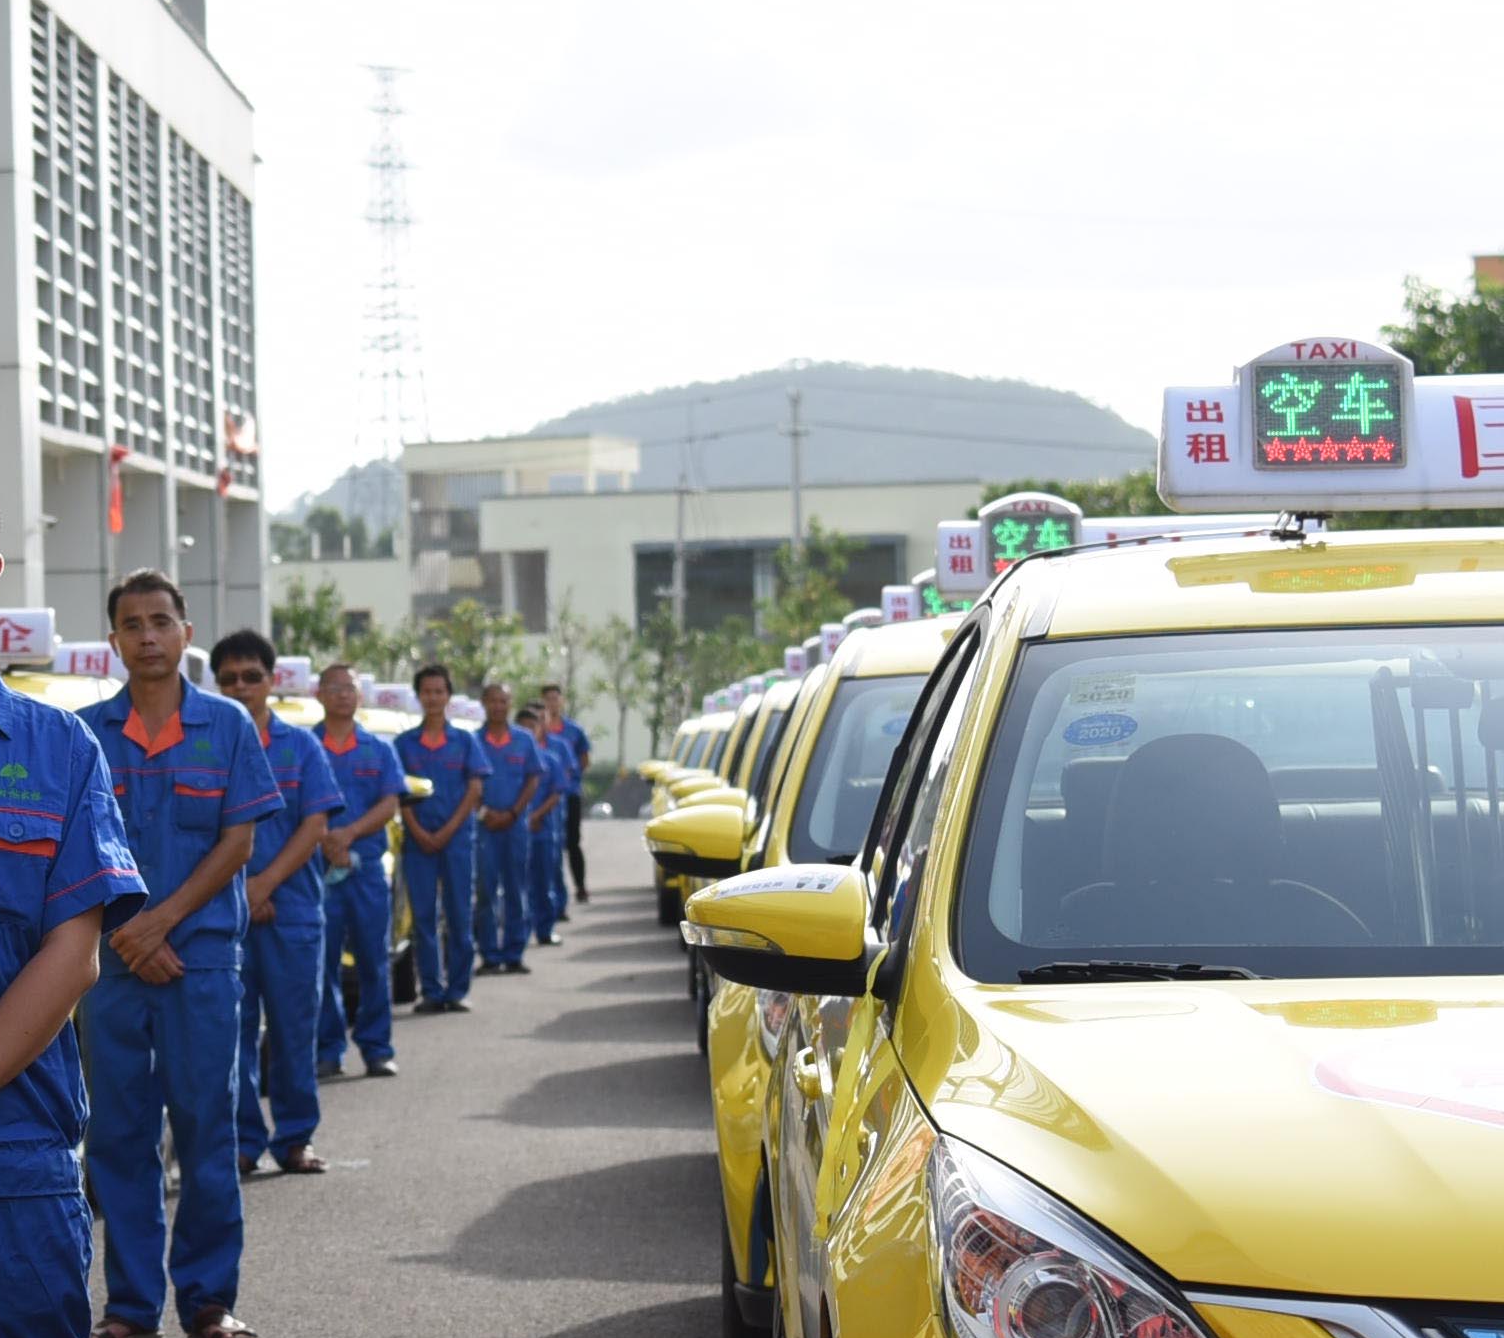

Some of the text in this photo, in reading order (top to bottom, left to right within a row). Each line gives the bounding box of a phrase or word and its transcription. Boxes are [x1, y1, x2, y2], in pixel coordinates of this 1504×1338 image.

[1293, 342, 1358, 359] TAXI
[1261, 372, 1394, 436] 空车
[1185, 400, 1229, 464] 出租
[948, 533, 974, 574] 出租
[1079, 727, 1121, 740] 2020
